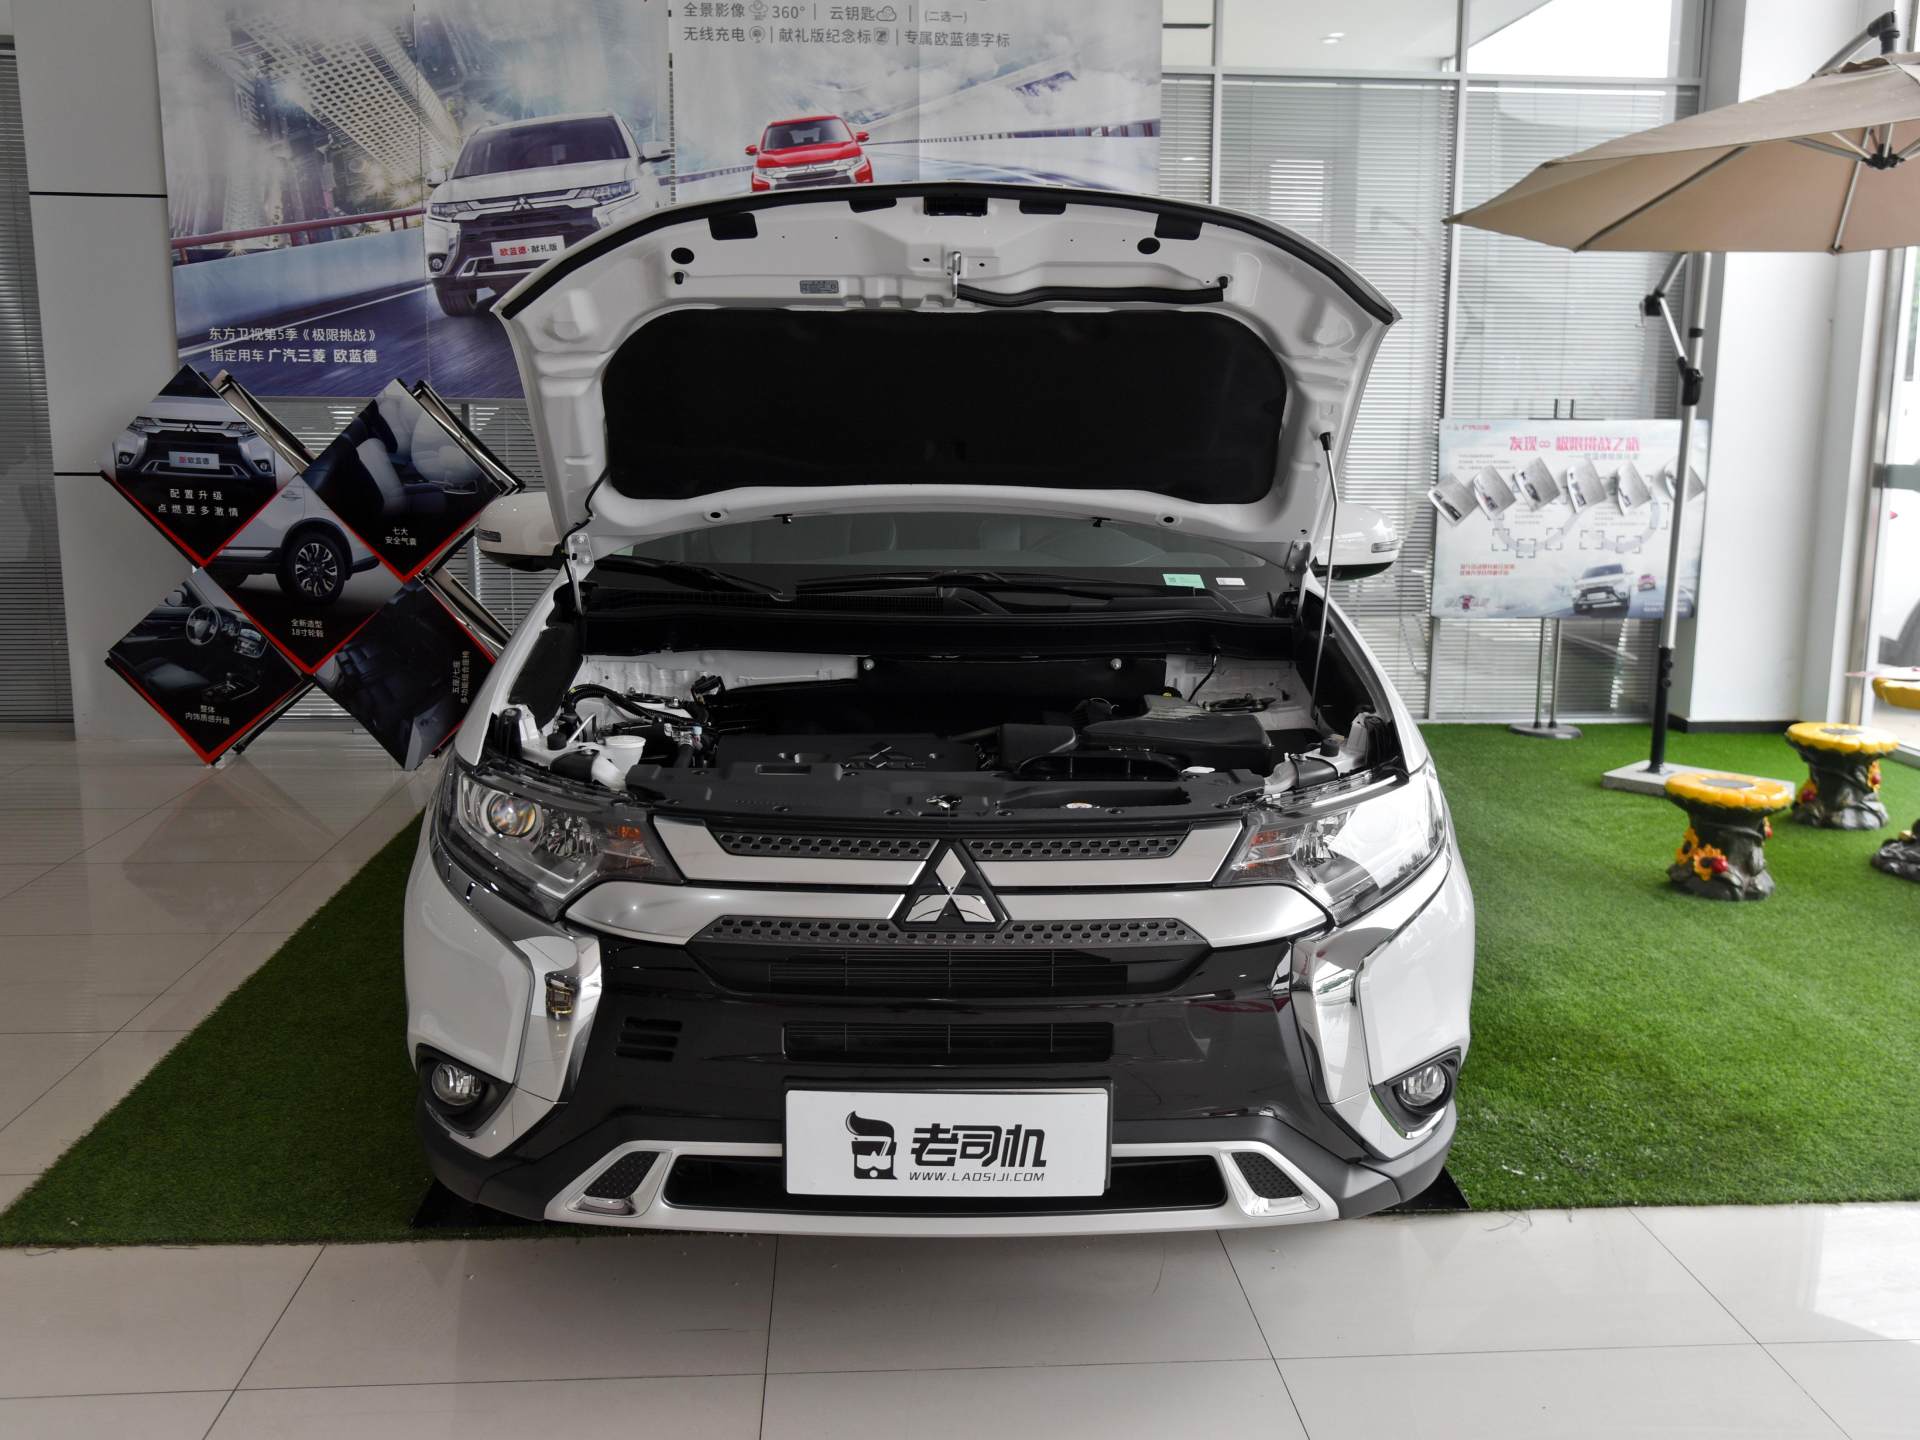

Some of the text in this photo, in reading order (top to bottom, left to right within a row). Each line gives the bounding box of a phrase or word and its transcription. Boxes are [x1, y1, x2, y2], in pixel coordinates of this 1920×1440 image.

[683, 2, 745, 18] 全景影像
[830, 6, 875, 21] 云钥匙
[683, 26, 1010, 47] 无线充电 献礼版纪念标 专属欧蓝德字标
[210, 348, 378, 363] 指定用车 广汽三菱 欧蓝德
[169, 488, 223, 500] 配置升级
[158, 503, 239, 517] 点燃更多激情
[392, 527, 409, 536] 七大
[910, 1123, 1047, 1168] 老司机
[908, 1171, 1045, 1183] WWW.LAOSIJI.COM
